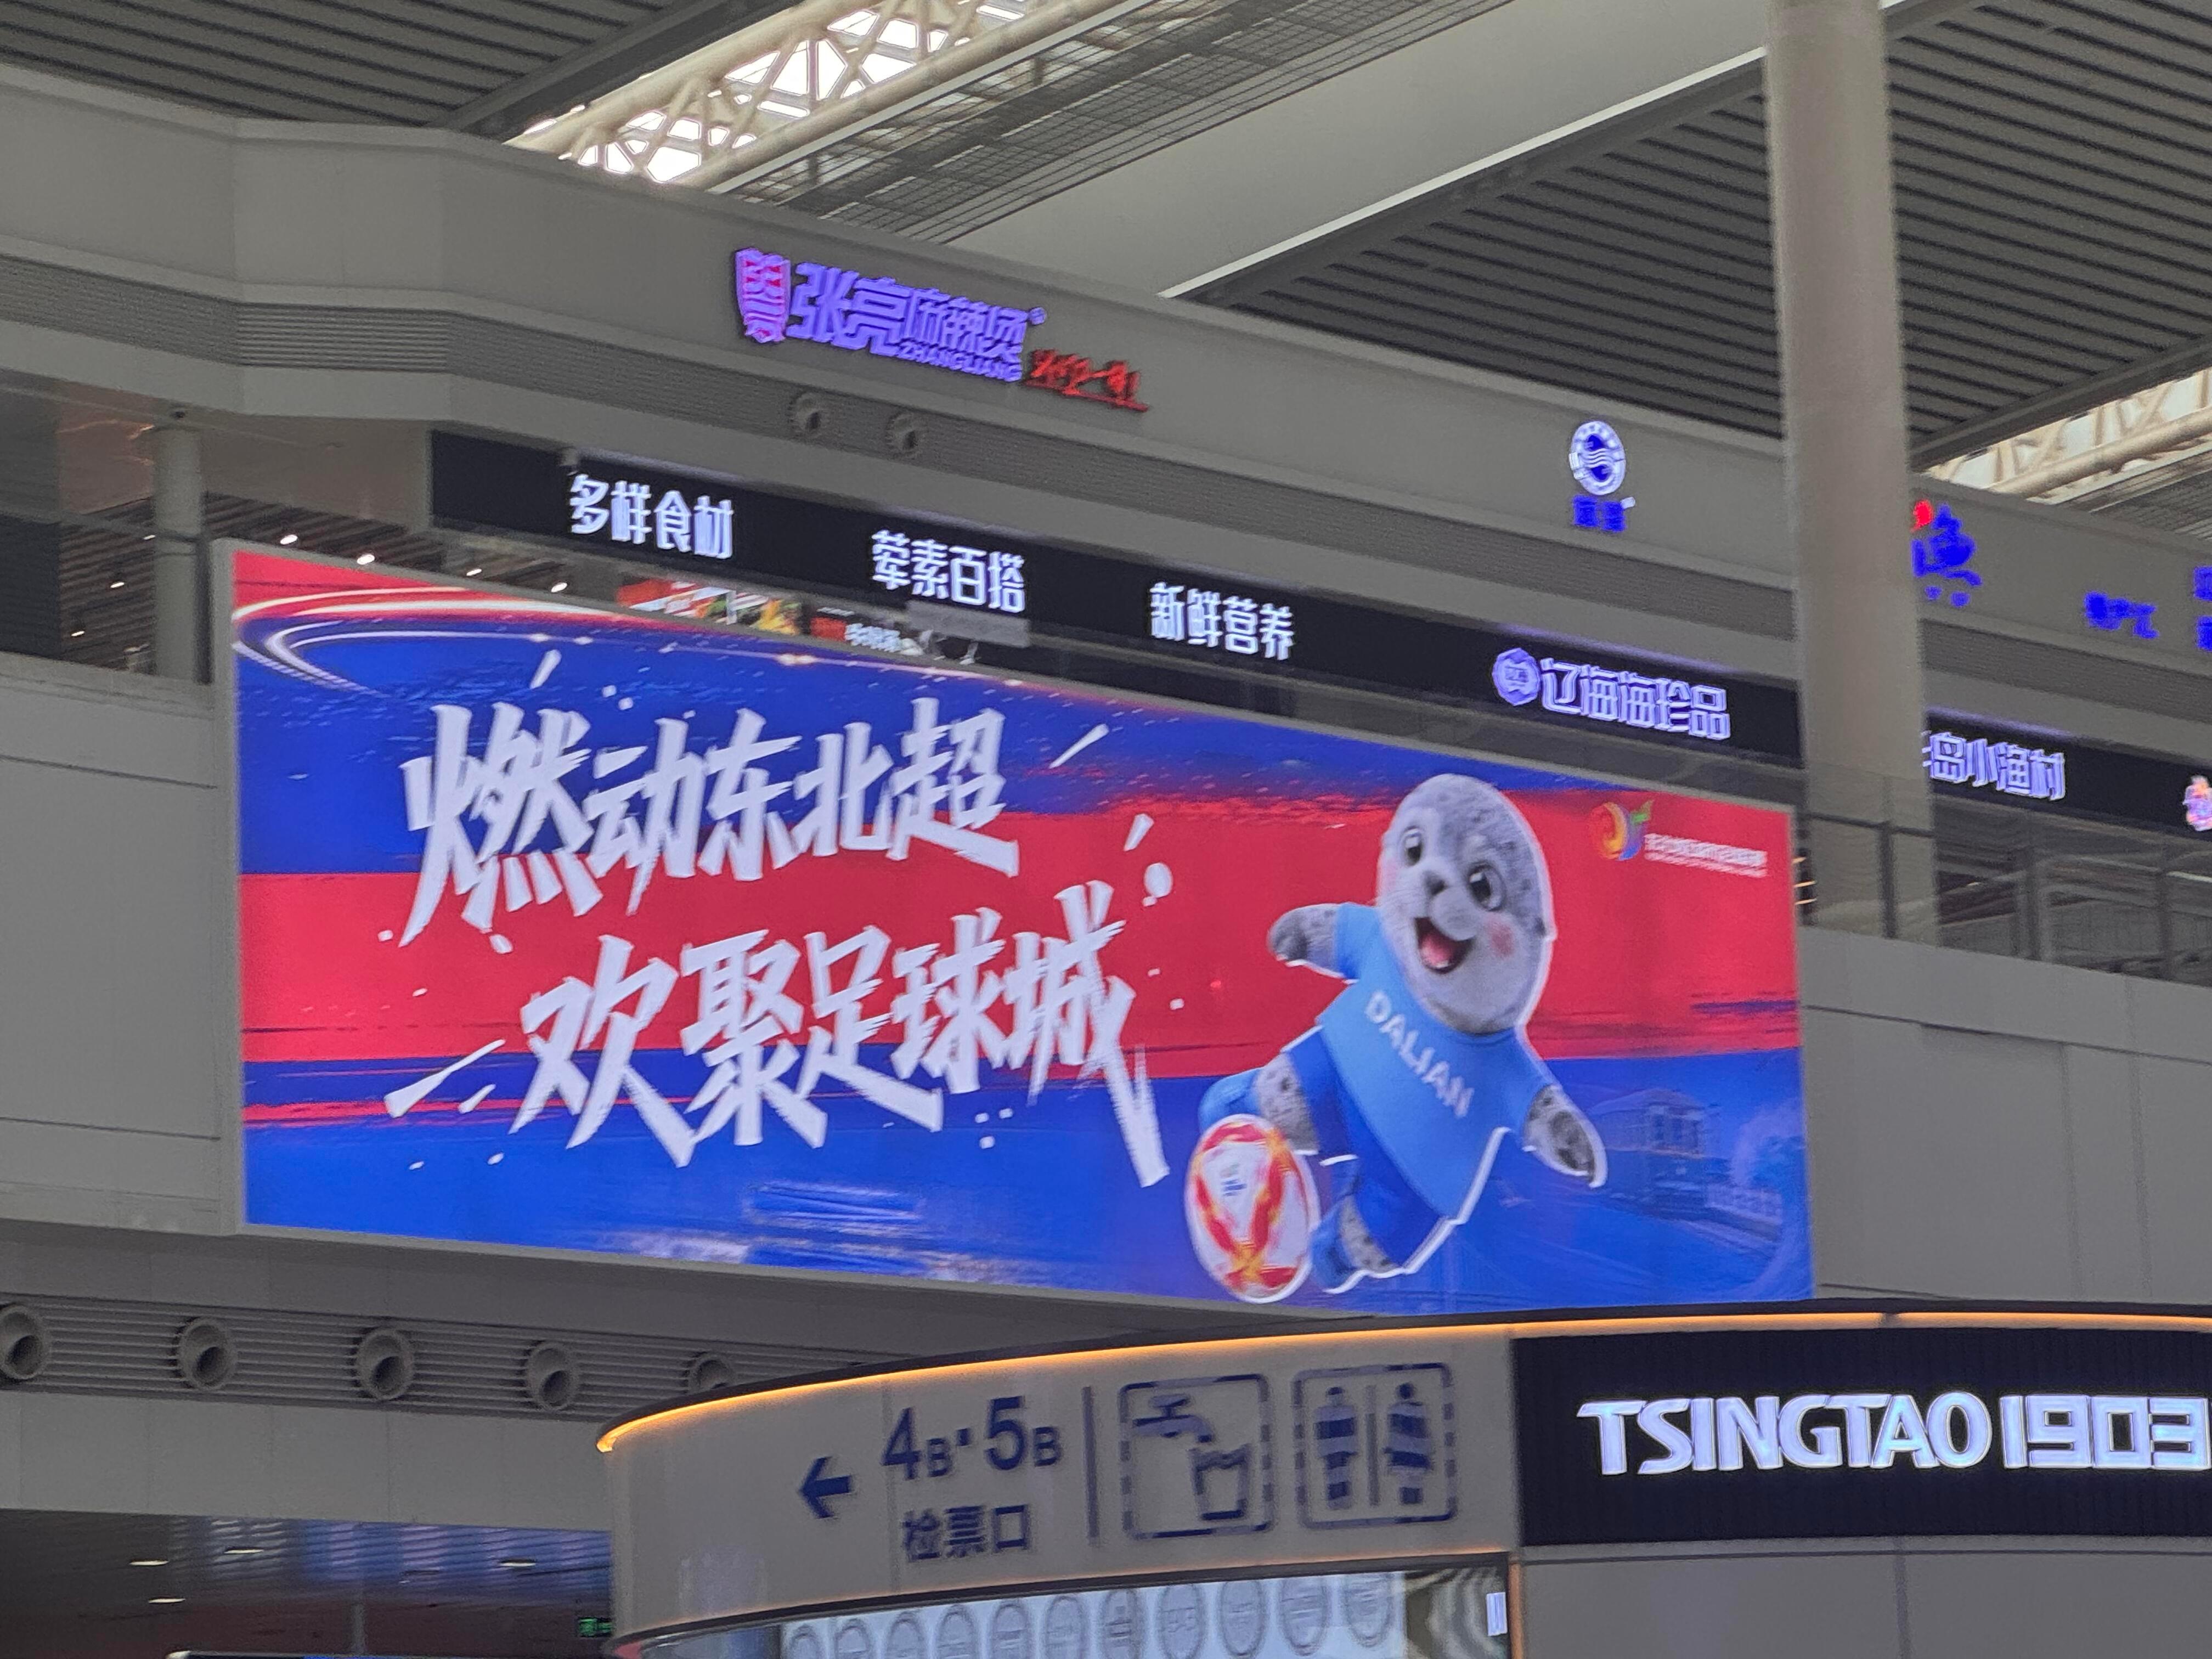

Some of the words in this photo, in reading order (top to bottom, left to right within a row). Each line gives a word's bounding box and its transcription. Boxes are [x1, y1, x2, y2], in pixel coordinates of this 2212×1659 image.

[569, 473, 734, 559] 多样食材
[872, 529, 1025, 613] 荤素百搭
[1150, 582, 1295, 660] 新鲜营养
[1921, 731, 2066, 801] 岛小渔村
[399, 697, 1019, 947] 燃动东北超
[509, 880, 1169, 1187] 欢聚足球城
[1364, 989, 1475, 1118] DALIAN
[1576, 1391, 1993, 1475] TSINGTAO
[1999, 1394, 2211, 1471] 1903
[902, 1503, 1031, 1562] 检票口
